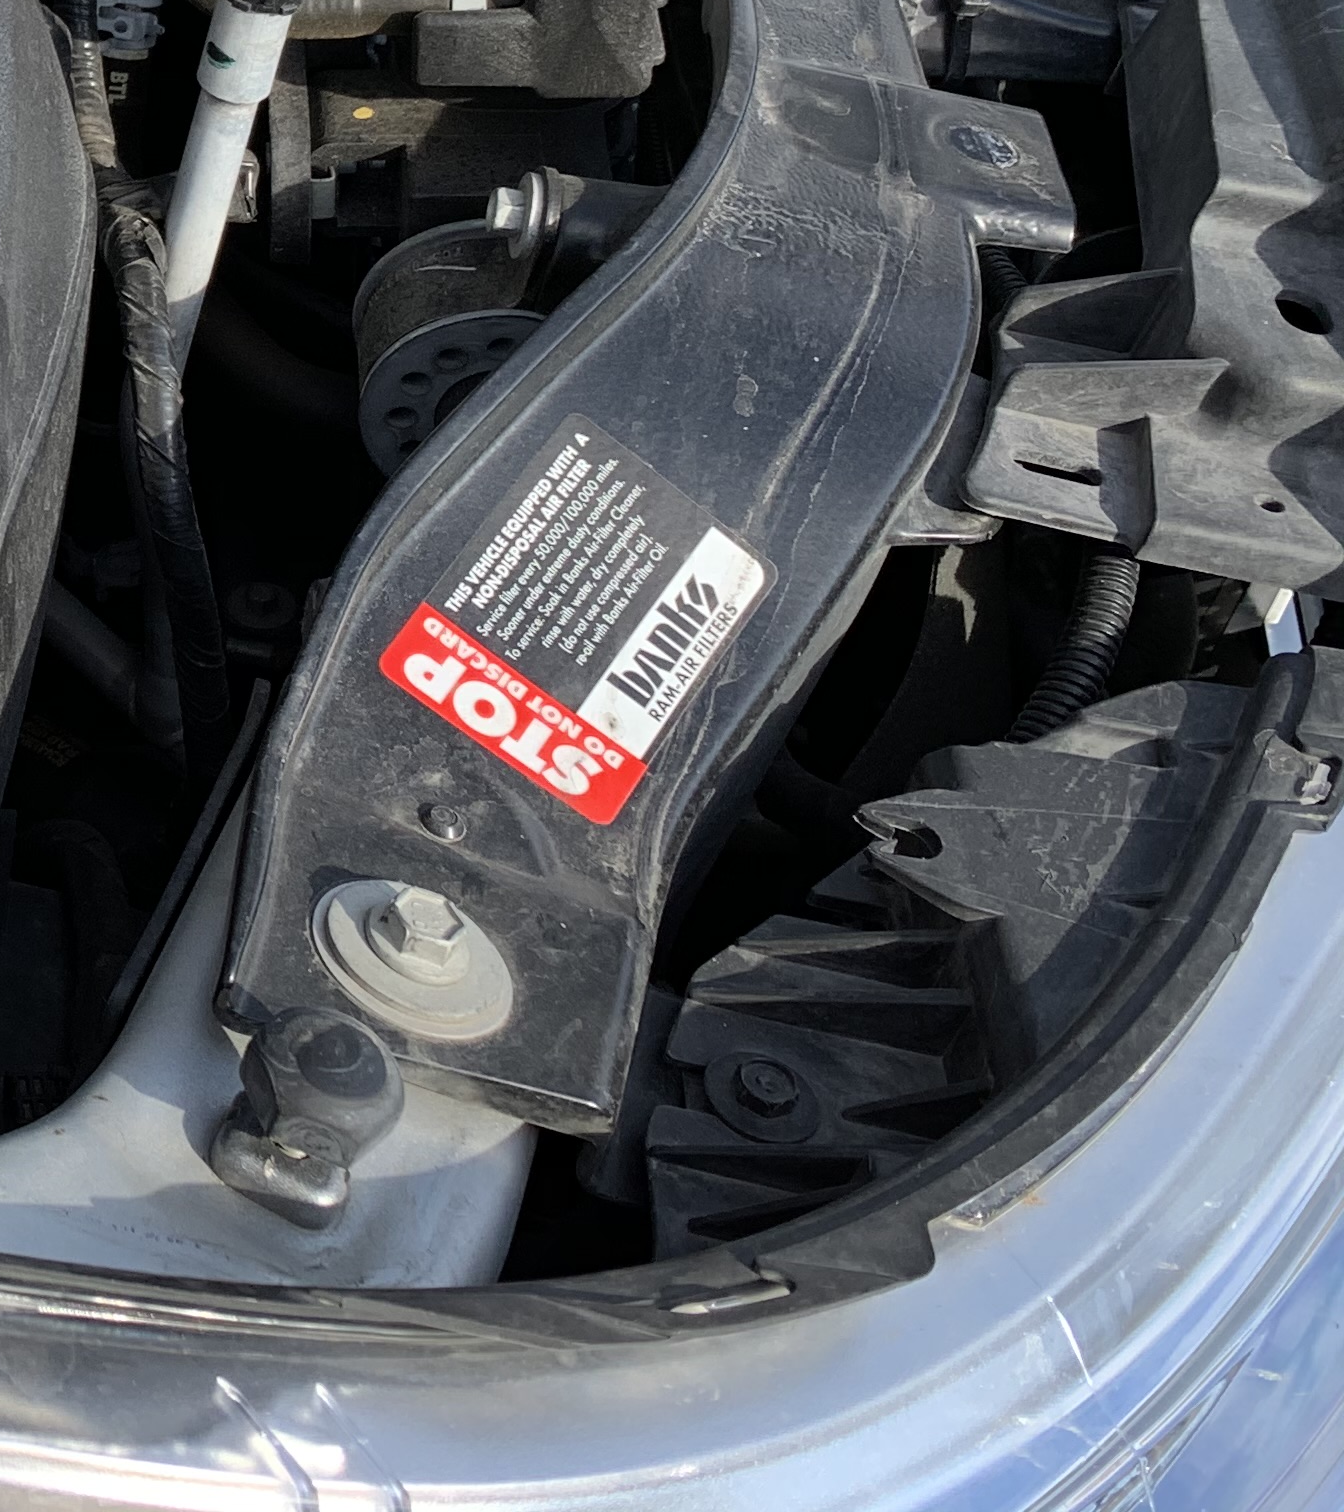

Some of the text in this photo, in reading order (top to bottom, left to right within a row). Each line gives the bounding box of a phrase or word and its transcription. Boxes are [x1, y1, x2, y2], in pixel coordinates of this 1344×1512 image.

[443, 432, 589, 612] THIS VEHICLE EQUIPPED WITH A
[471, 458, 591, 609] NON-DISPOSAL AIR FILTER
[475, 458, 619, 636] Service filter every 50,000/100,000 miles.
[496, 479, 625, 641] Sooner under extreme dusty conditions.
[504, 484, 646, 660] To service: Soak in Banks Air-Filter Cleaner,
[541, 514, 645, 648] rinse with water, dry completely
[557, 532, 653, 653] (do not use compressed air).
[575, 541, 669, 666] re-oil with Banks Air-Filter Oil.
[647, 601, 737, 722] RAM-AIR FILTERS
[403, 653, 602, 795] STOP
[423, 617, 624, 769] DO NOT DISCARD
